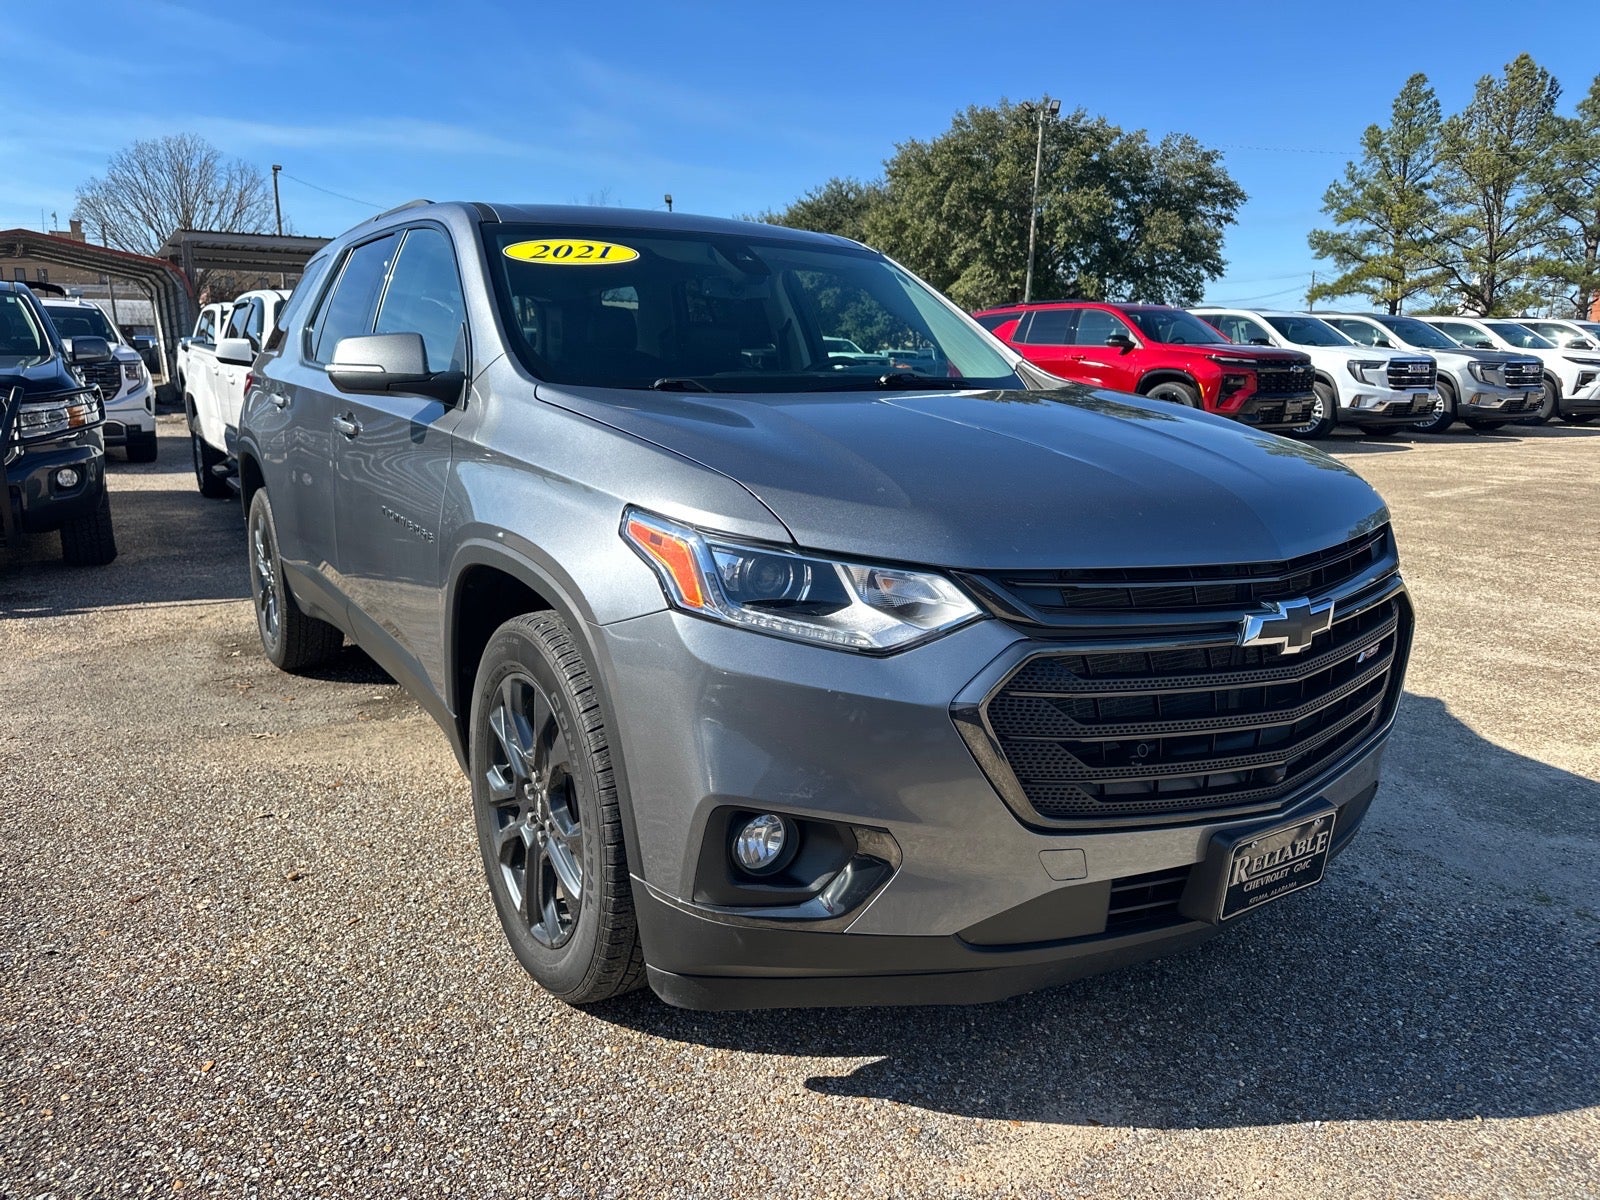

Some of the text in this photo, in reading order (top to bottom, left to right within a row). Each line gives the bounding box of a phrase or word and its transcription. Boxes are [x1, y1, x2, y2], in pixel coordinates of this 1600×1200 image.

[529, 244, 611, 259] 2021
[1229, 831, 1329, 887] RELIABLE
[1243, 859, 1312, 892] CHEVROLET GMC
